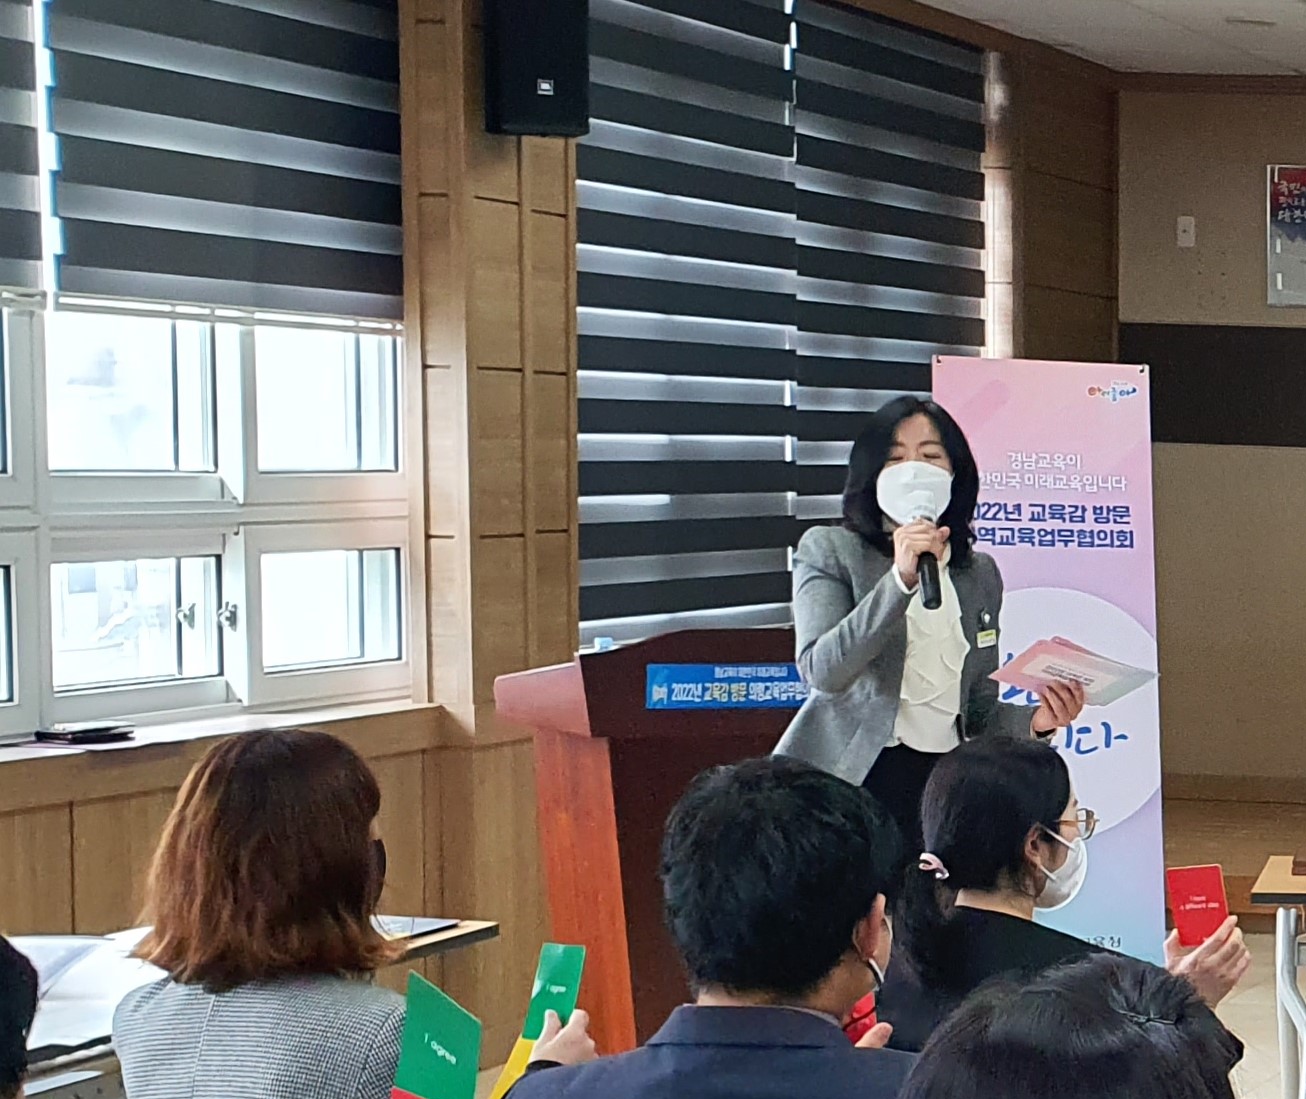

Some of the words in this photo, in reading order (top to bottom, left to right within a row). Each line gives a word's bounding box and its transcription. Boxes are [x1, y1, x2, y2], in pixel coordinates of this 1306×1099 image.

[1008, 452, 1081, 470] 경남교육이
[978, 473, 1022, 490] 한민국
[1024, 474, 1127, 492] 미래교육입니다
[975, 502, 1022, 522] 022년
[1028, 503, 1088, 524] 교육감
[1093, 505, 1131, 525] 방문
[977, 527, 1134, 549] 역교육업무협의회
[672, 683, 702, 702] 2022년
[704, 683, 729, 702] 교육감
[430, 1040, 457, 1065] agree
